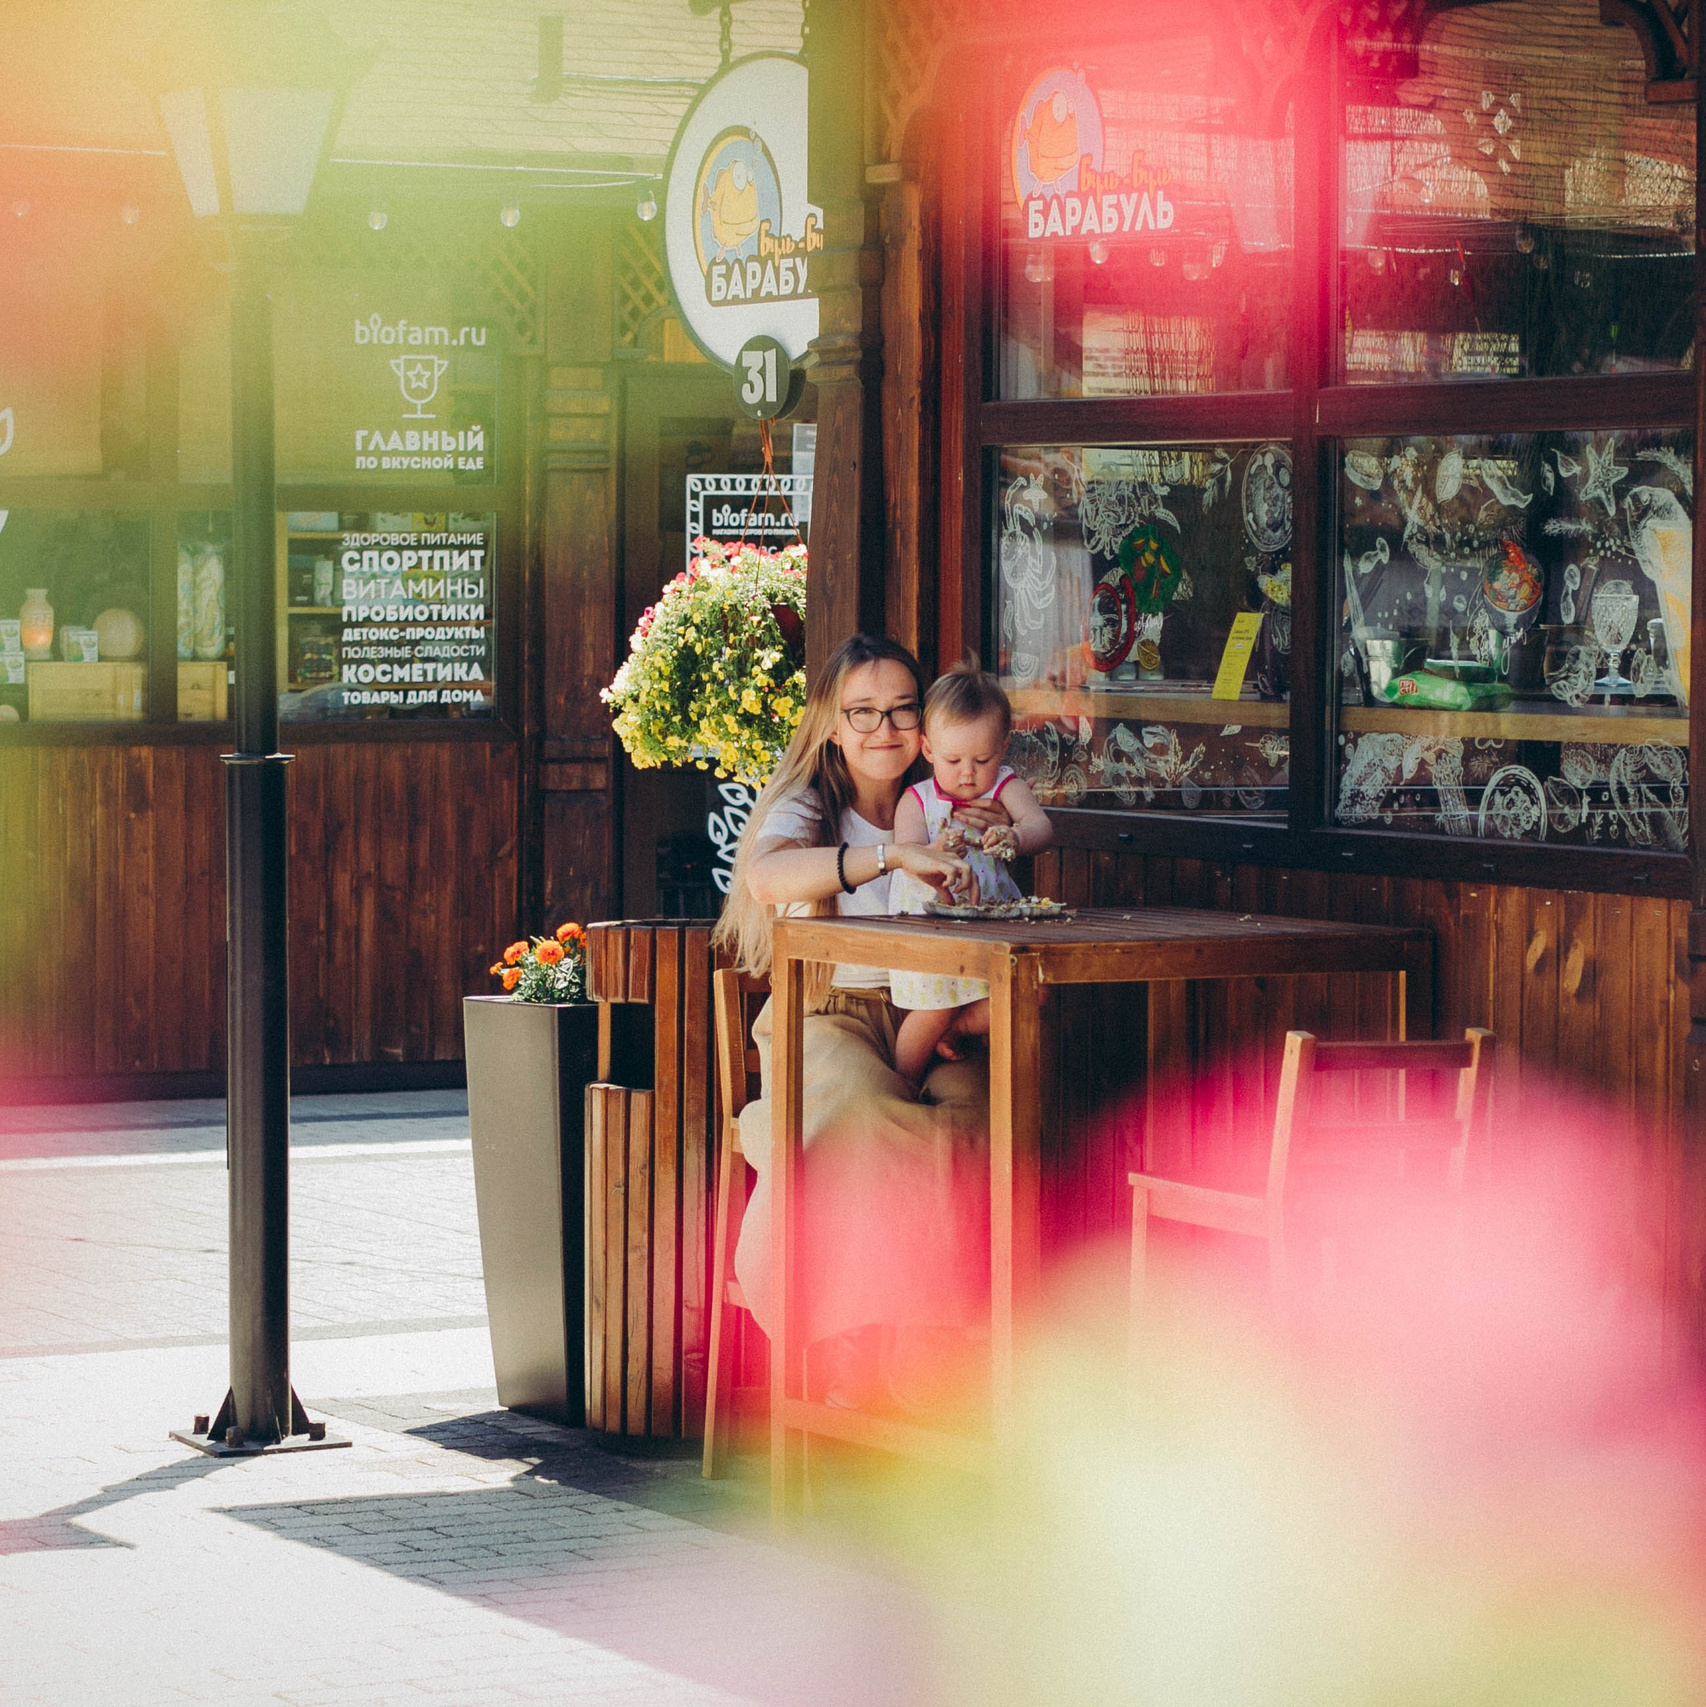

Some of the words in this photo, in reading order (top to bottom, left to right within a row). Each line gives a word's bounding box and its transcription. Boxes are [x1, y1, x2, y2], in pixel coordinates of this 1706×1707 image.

[1027, 190, 1175, 239] БАРАБУЛЬ
[711, 256, 813, 302] БАРАБУ
[354, 312, 487, 346] biofam.ru
[741, 348, 778, 405] 31
[354, 424, 485, 452] ГЛАВНЫЙ
[355, 456, 379, 470] ПО
[381, 453, 455, 470] ВКУСНОЙ
[457, 456, 485, 471] ЕДЕ
[711, 503, 800, 527] biofam.ru
[342, 532, 418, 547] ЗДОРОВОЕ
[420, 532, 484, 546] ПИТАНИЕ
[341, 549, 486, 572] СПОРТПИТ
[342, 577, 485, 600] ВИТАМИНЫ
[341, 603, 485, 623] ПРОБИОТИКИ
[341, 626, 486, 642] ДЕТОКС-ПРОДУКТЫ
[341, 645, 412, 659] ПОЛЕЗНЫЕ
[413, 644, 486, 659] СЛАДОСТИ
[341, 661, 485, 684] КОСМЕТИКА
[341, 689, 404, 705] ТОВАРЫ
[406, 689, 438, 705] ДЛЯ
[439, 688, 486, 704] ДОМА
